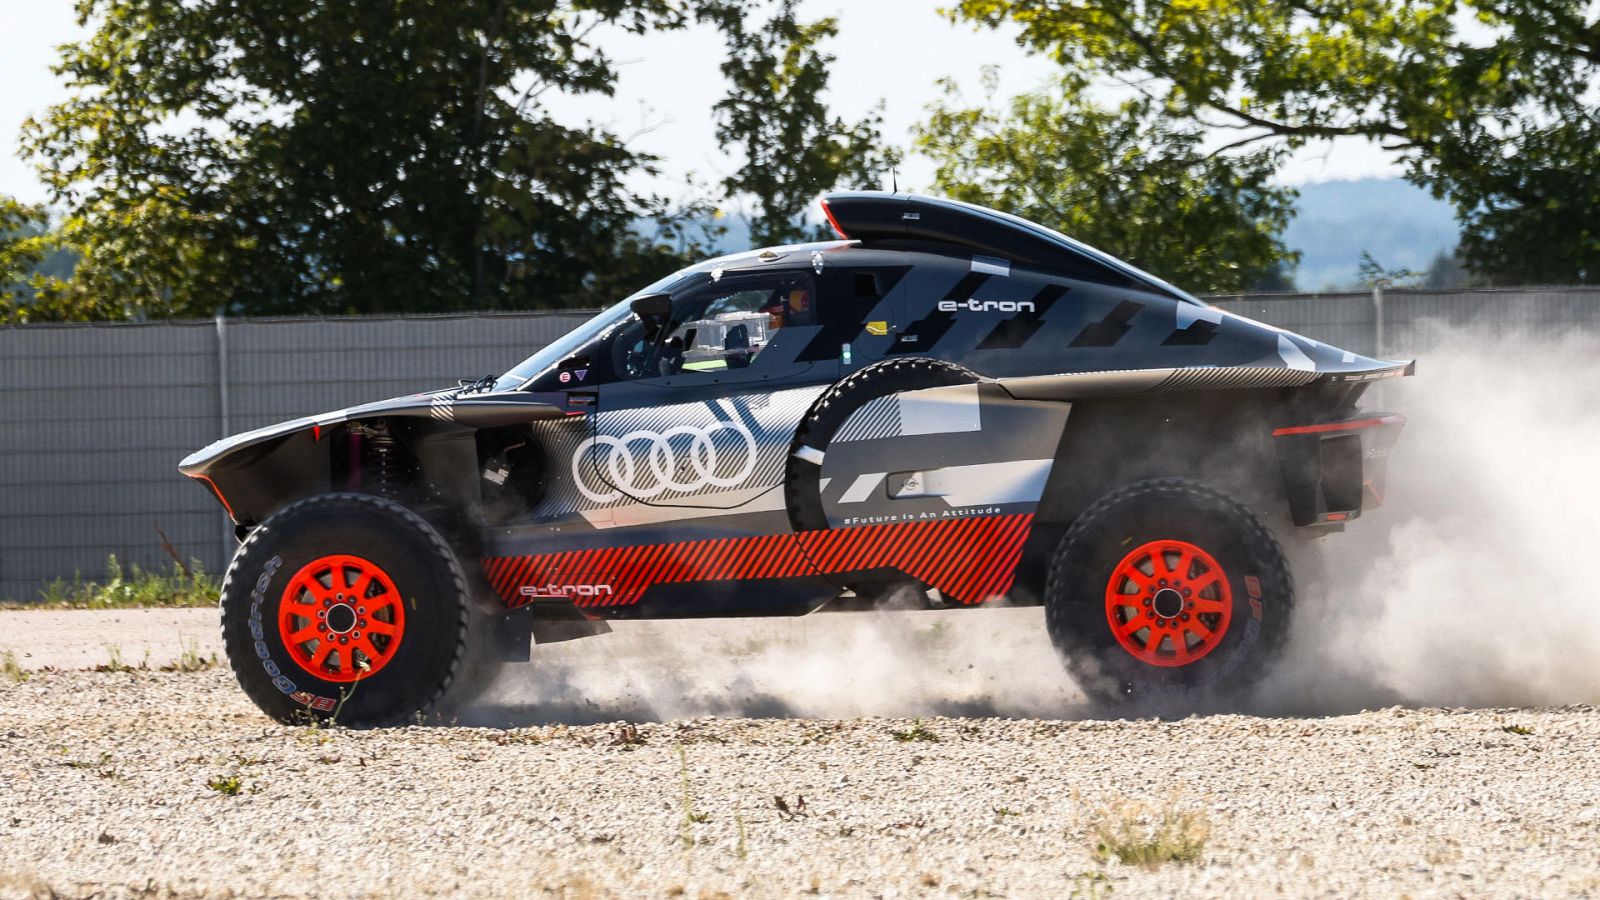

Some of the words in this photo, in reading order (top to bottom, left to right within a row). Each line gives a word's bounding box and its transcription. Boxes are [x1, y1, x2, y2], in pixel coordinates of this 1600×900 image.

[938, 299, 1035, 312] e-tron
[844, 514, 898, 525] #Future
[919, 511, 937, 519] An
[942, 507, 1001, 517] Attitude
[520, 584, 612, 595] e-tron
